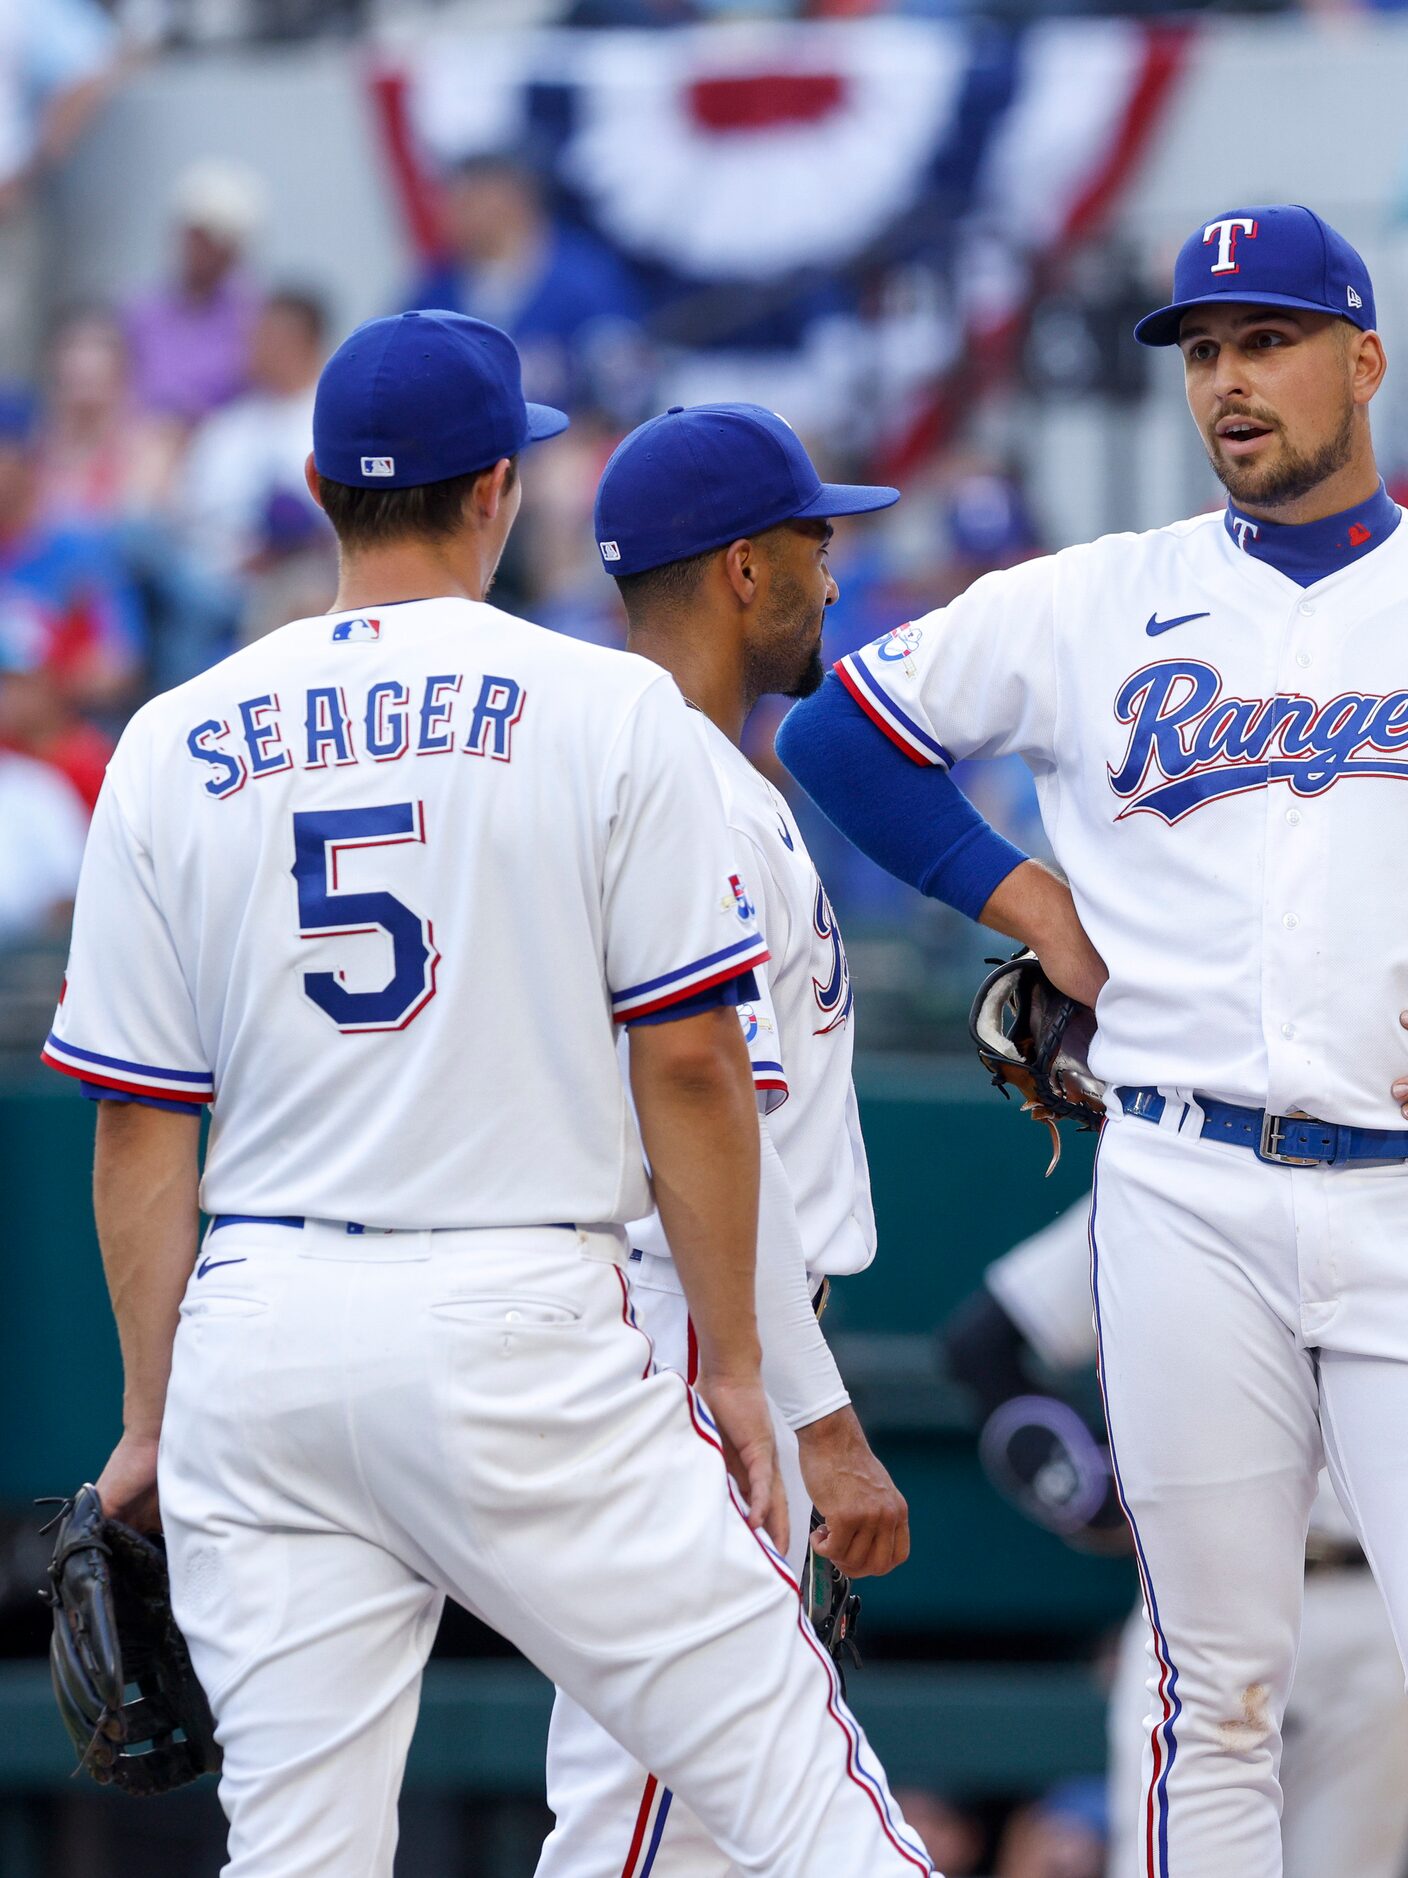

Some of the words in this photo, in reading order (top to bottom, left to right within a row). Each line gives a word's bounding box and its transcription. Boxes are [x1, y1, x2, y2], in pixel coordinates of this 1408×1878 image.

[1202, 218, 1258, 276] T
[1232, 516, 1261, 553] T
[186, 674, 526, 799] SEAGER
[290, 800, 441, 1034] 5
